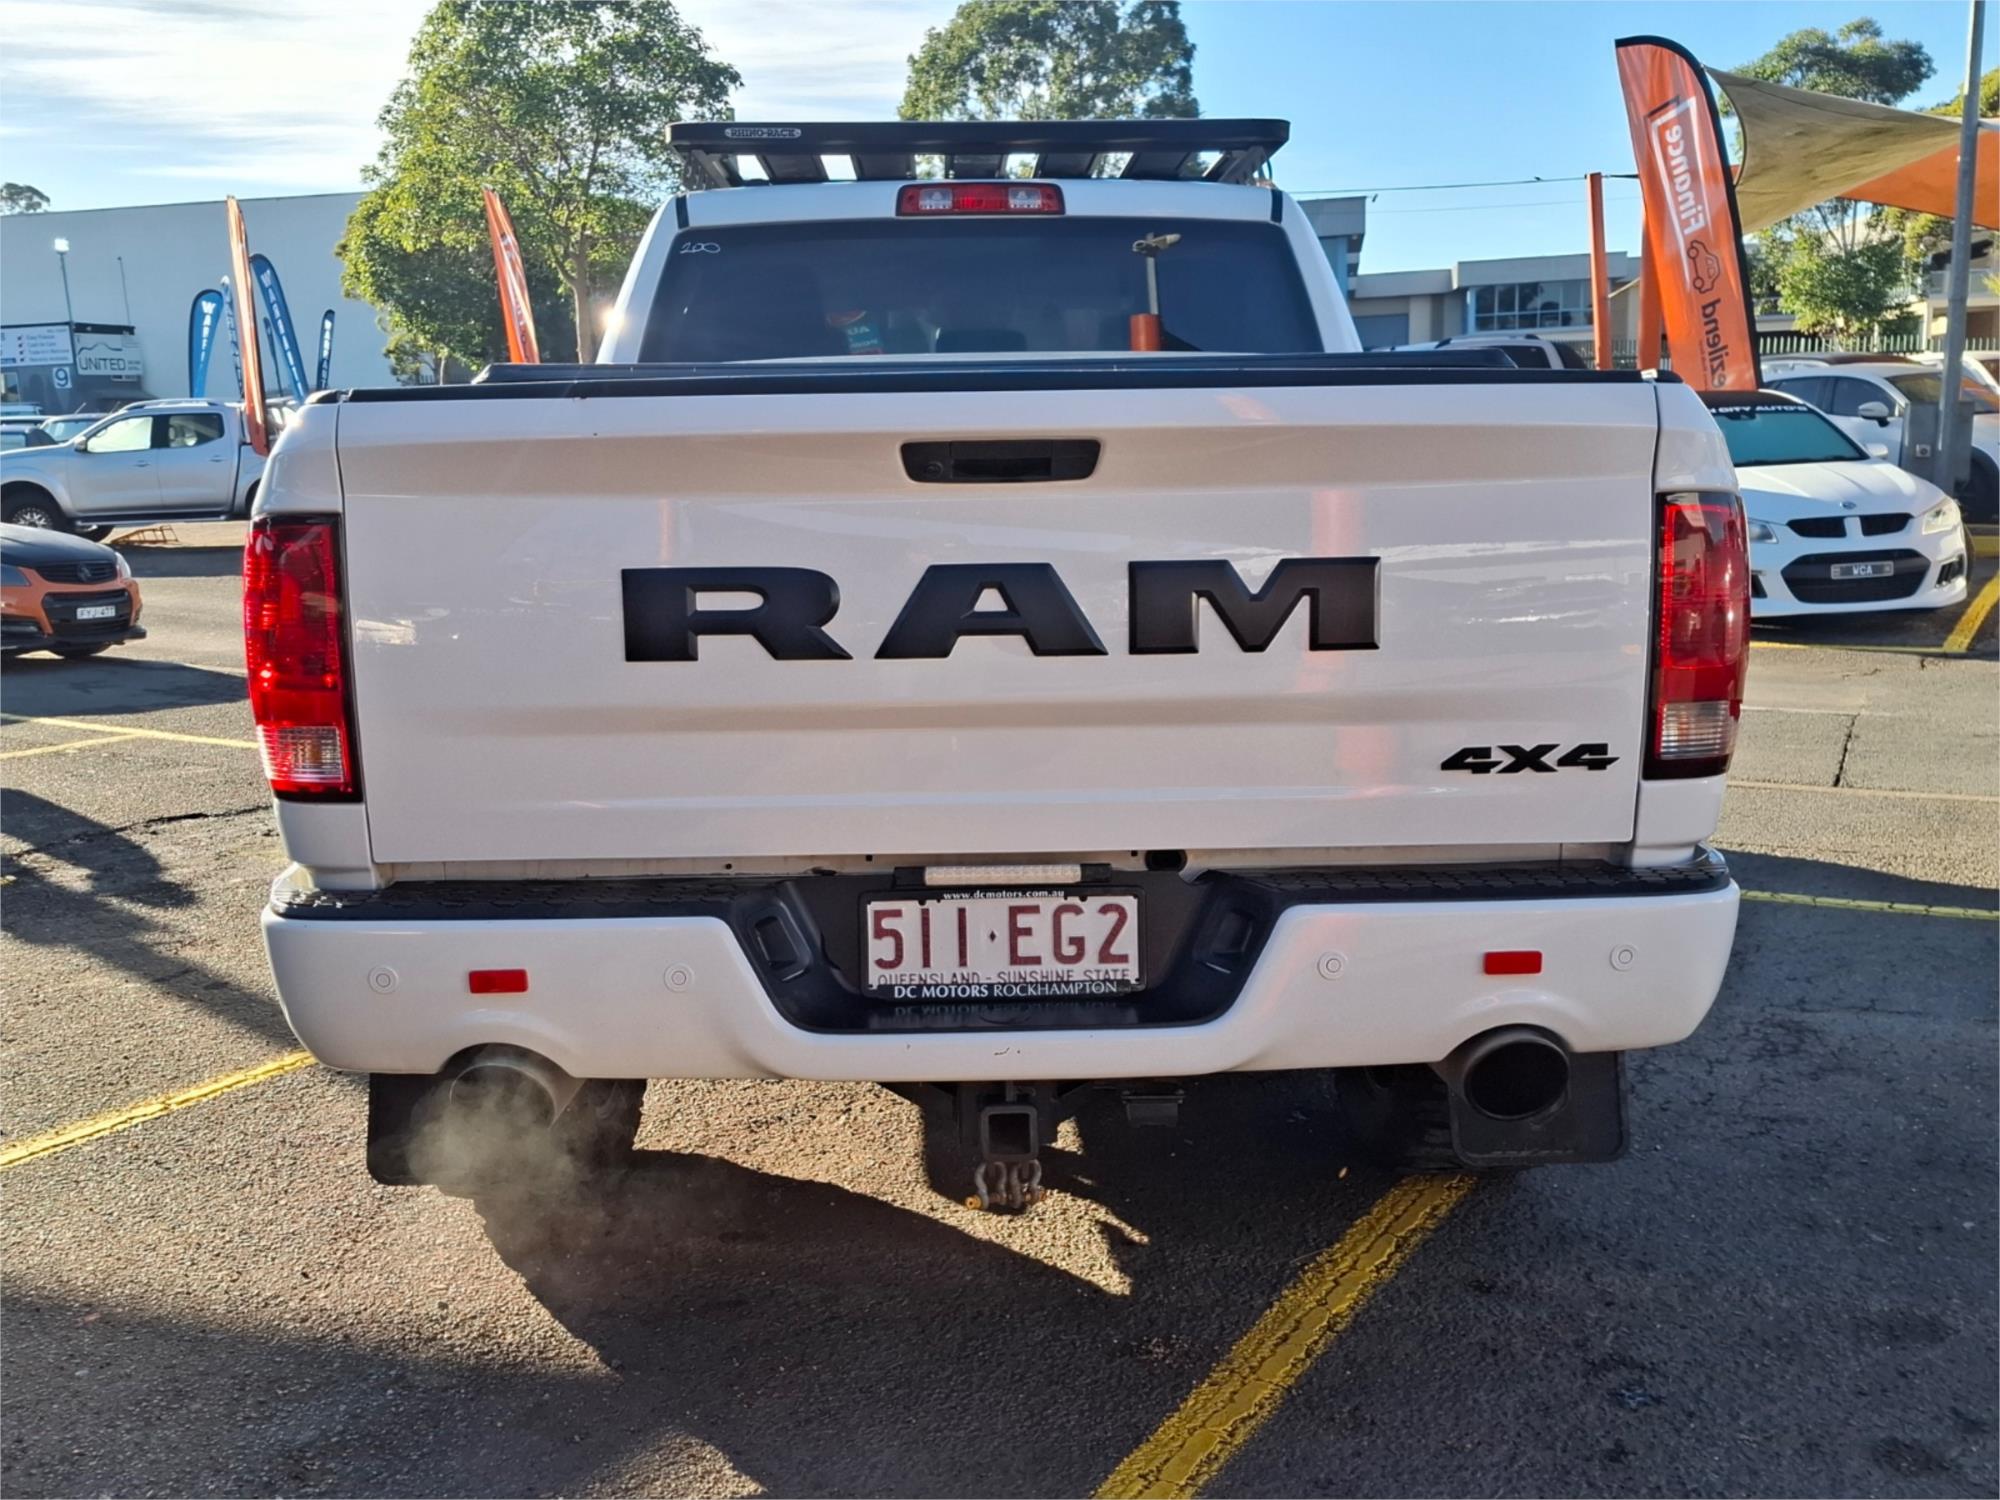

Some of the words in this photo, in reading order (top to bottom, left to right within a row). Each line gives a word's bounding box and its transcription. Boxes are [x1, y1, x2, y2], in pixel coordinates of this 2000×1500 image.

[731, 128, 797, 137] RHINO-RACK
[79, 357, 126, 370] UNITED
[55, 368, 69, 388] 9
[621, 556, 1381, 663] RAM
[1440, 743, 1620, 775] 4X4
[943, 889, 1065, 900] www.dcmotors.com.au
[873, 906, 968, 970] 511
[1008, 903, 1130, 966] EG2
[878, 971, 979, 985] QUEENSLAND
[997, 969, 1074, 984] SUNSHINE
[1084, 968, 1131, 981] STATE
[894, 985, 917, 999] DC
[921, 983, 989, 998] MOTORS
[994, 981, 1118, 997] ROCKHAMPTON
